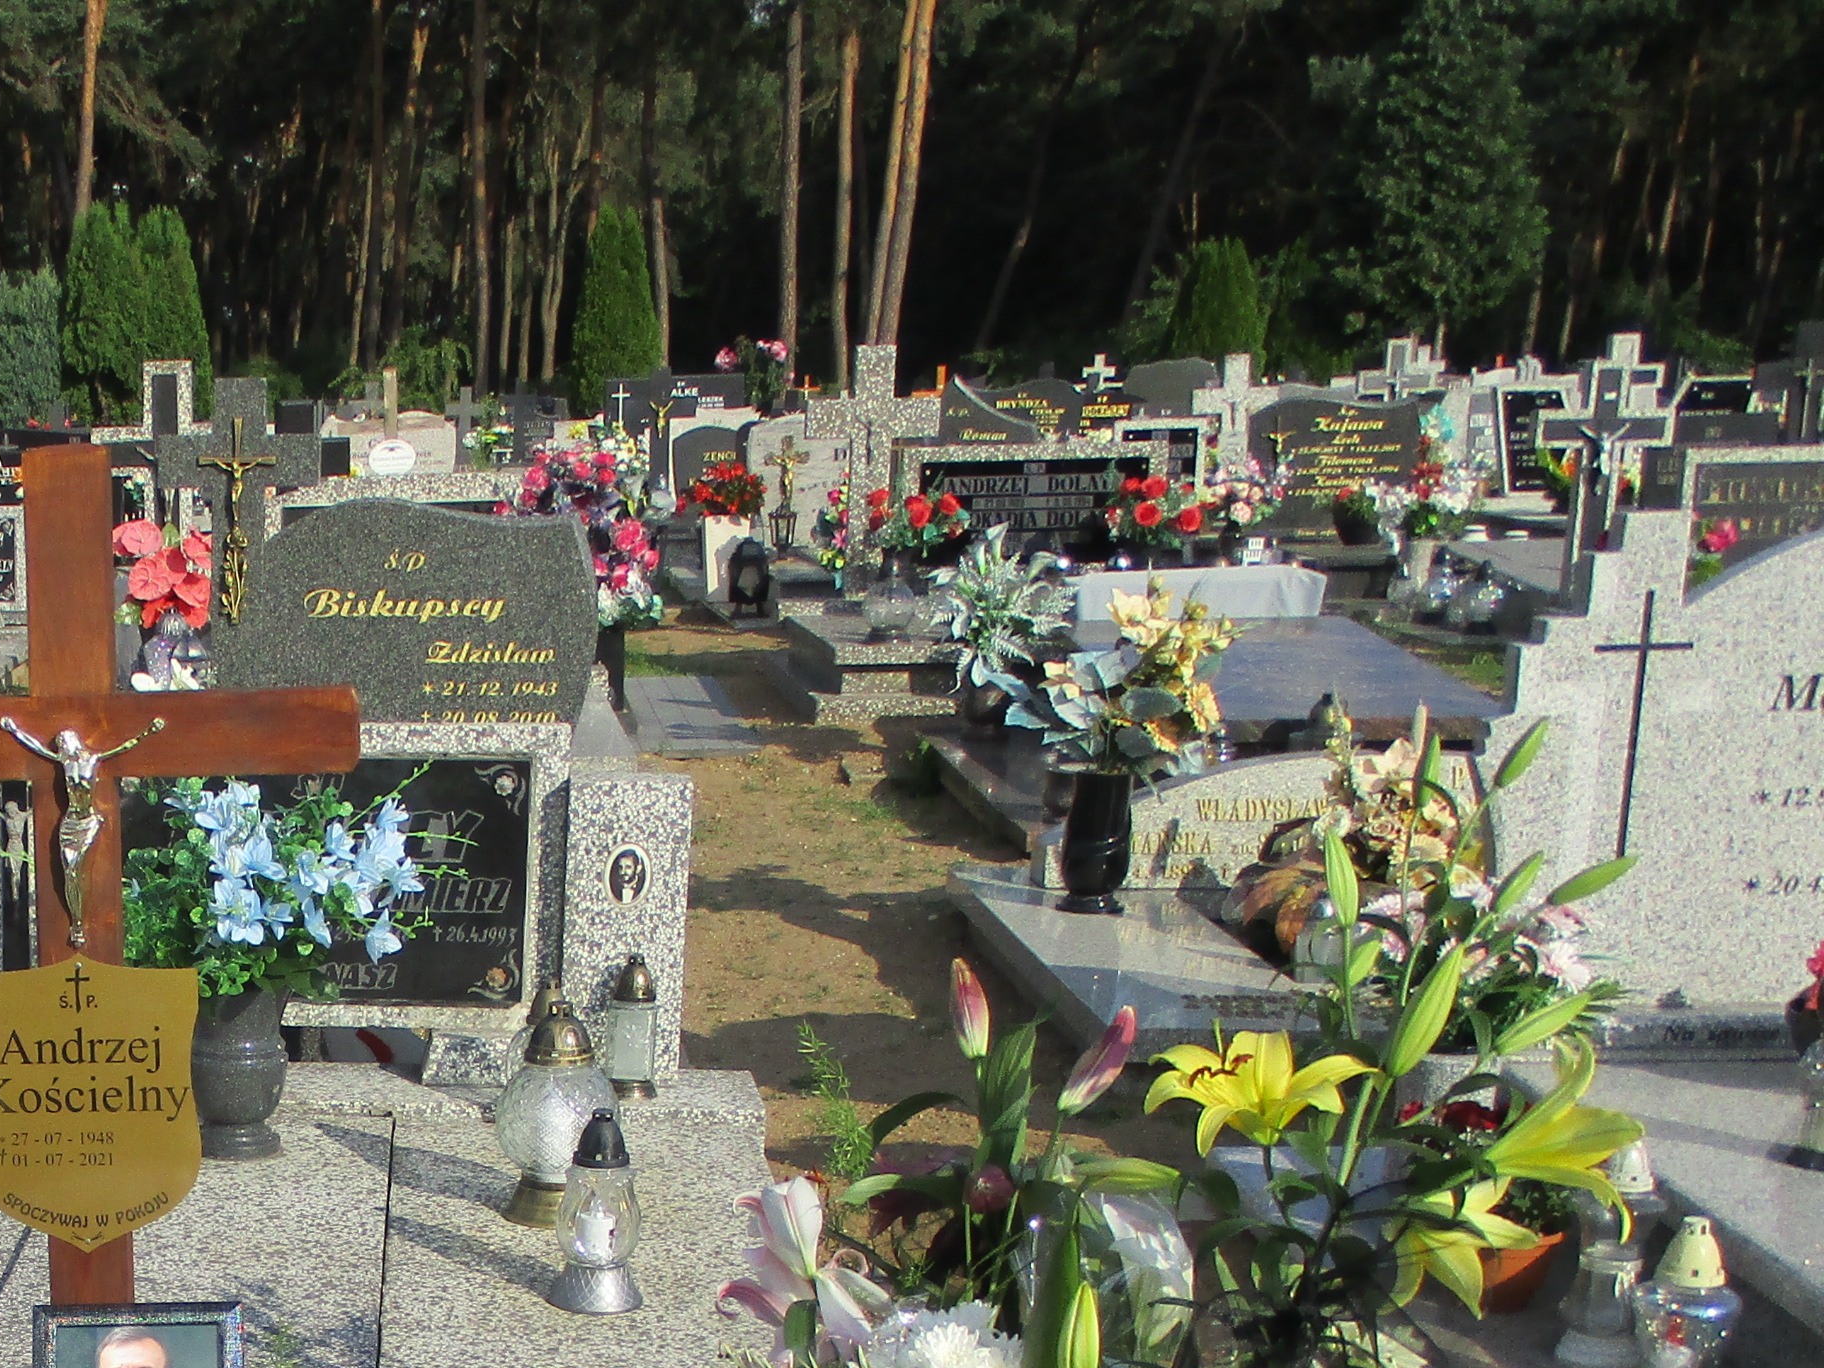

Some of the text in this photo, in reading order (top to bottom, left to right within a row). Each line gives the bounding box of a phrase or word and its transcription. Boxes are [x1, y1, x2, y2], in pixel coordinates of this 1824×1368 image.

[303, 588, 507, 624] Biskupscy
[2, 1191, 170, 1228] SPOCZYWAJ W POKOJU
